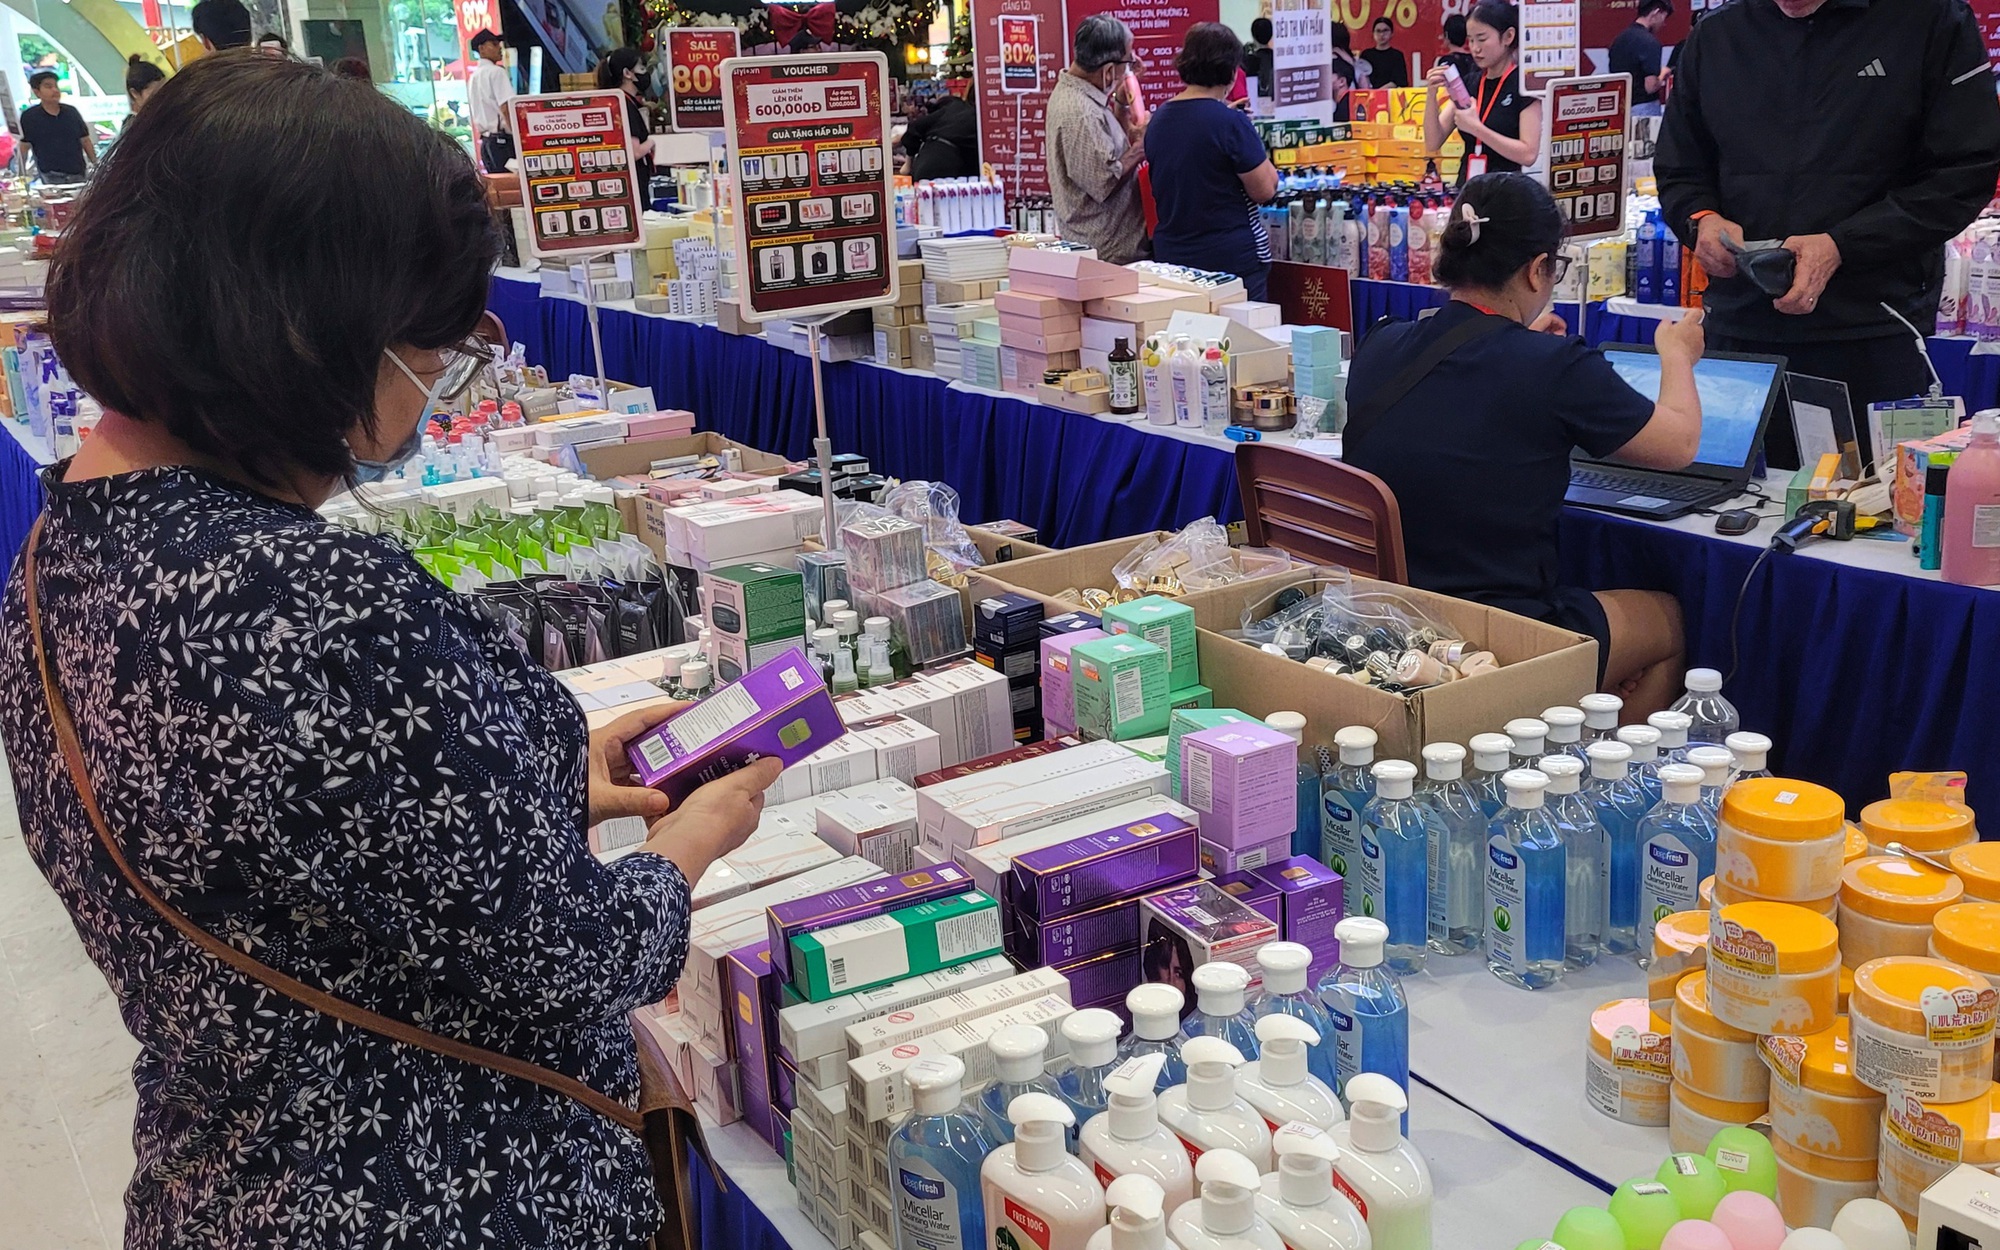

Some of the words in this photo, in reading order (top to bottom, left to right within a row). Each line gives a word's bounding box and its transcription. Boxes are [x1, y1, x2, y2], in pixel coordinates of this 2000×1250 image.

[1011, 25, 1026, 33] SALE
[1141, 20, 1154, 29] TÂN
[690, 41, 718, 51] SALE
[1003, 42, 1036, 65] 80%
[1153, 48, 1173, 56] CROCS
[688, 54, 703, 62] UP
[705, 54, 720, 62] TO
[783, 66, 829, 76] VOUCHER
[551, 100, 584, 108] VOUCHER
[774, 94, 787, 103] LÊN
[788, 94, 803, 102] ĐẾN
[756, 102, 822, 118] 600,000Đ
[533, 122, 580, 132] 600,000Đ
[772, 129, 790, 140] QUÀ
[792, 129, 814, 140] TẶNG
[814, 126, 832, 137] HẤP
[833, 125, 849, 135] DẪN
[1326, 818, 1351, 837] Micellar
[1490, 866, 1516, 886] Micellar
[1650, 865, 1685, 883] Micellar
[1647, 874, 1671, 889] Cleansing
[1671, 882, 1689, 891] Water
[904, 1197, 945, 1222] Micellar
[901, 1209, 929, 1229] Cleansing
[930, 1220, 951, 1232] Water
[1012, 1210, 1027, 1226] FREE
[1027, 1217, 1044, 1233] 100G
